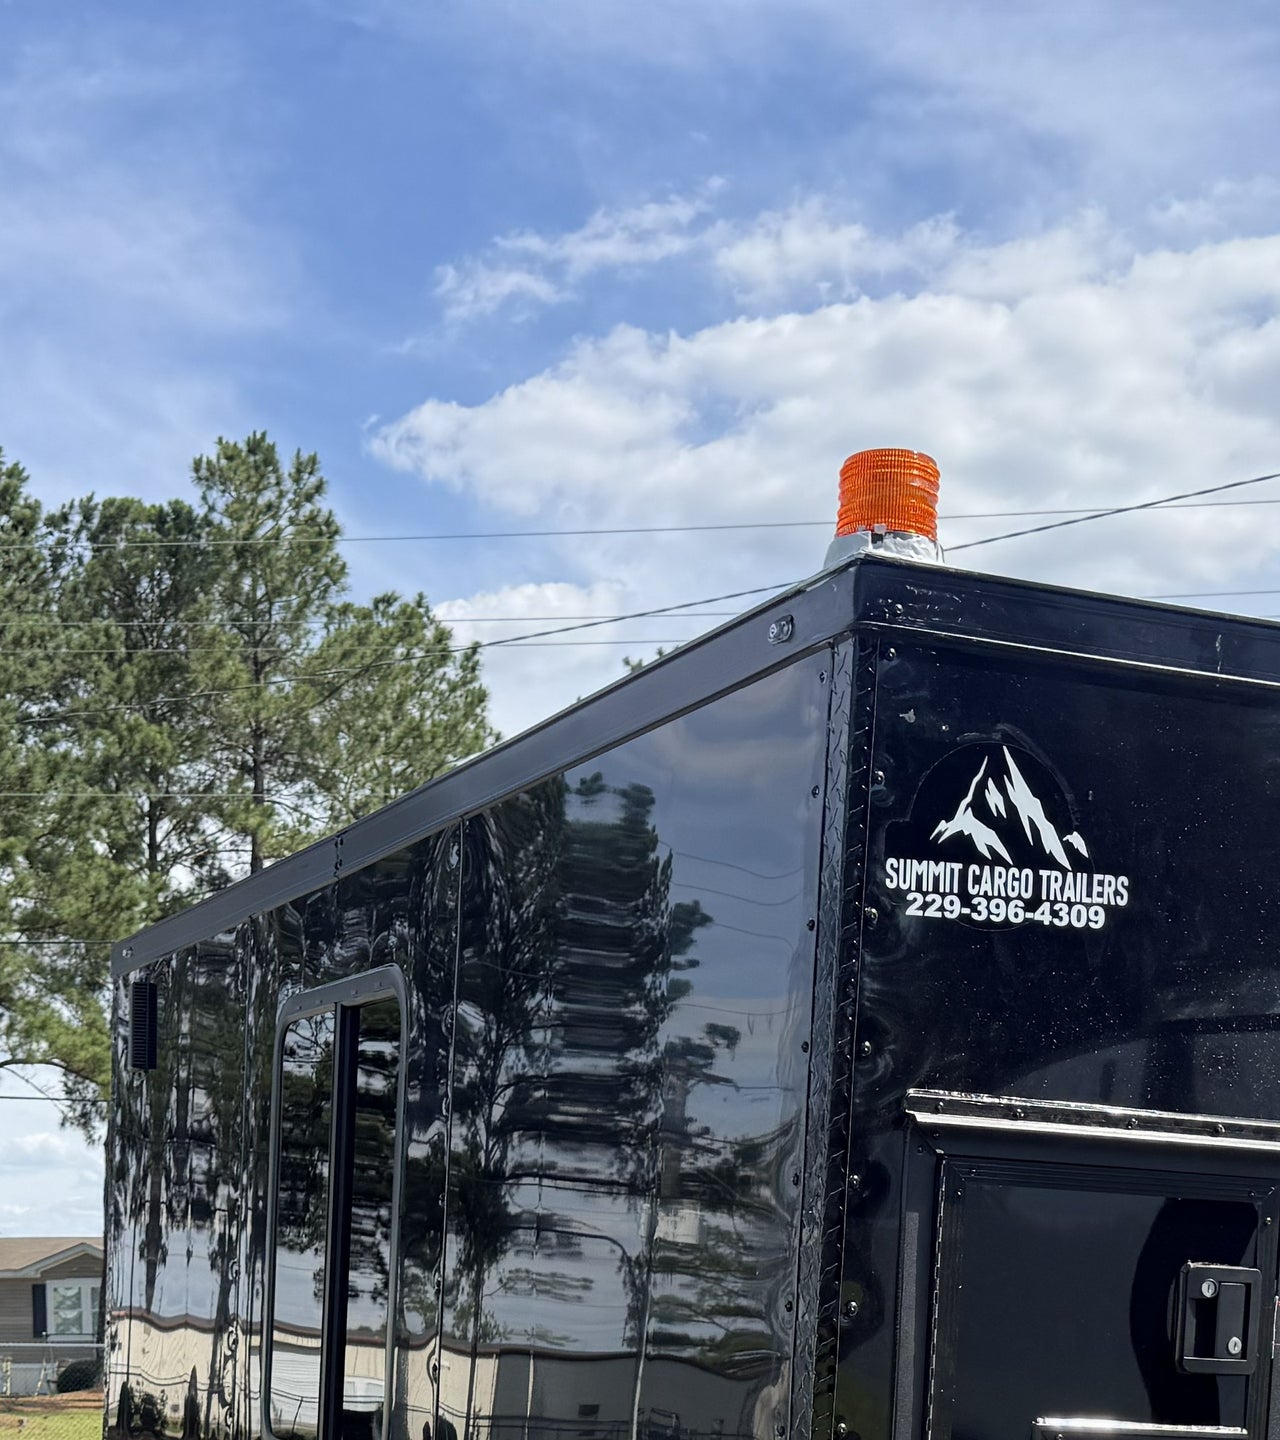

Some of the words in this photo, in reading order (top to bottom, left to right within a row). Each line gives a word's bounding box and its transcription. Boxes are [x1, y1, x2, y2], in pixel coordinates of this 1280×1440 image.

[885, 857, 963, 894] SUMMIT
[967, 864, 1033, 899] CARGO
[1039, 870, 1129, 906] TRAILERS
[905, 892, 1106, 929] 229-396-4309
